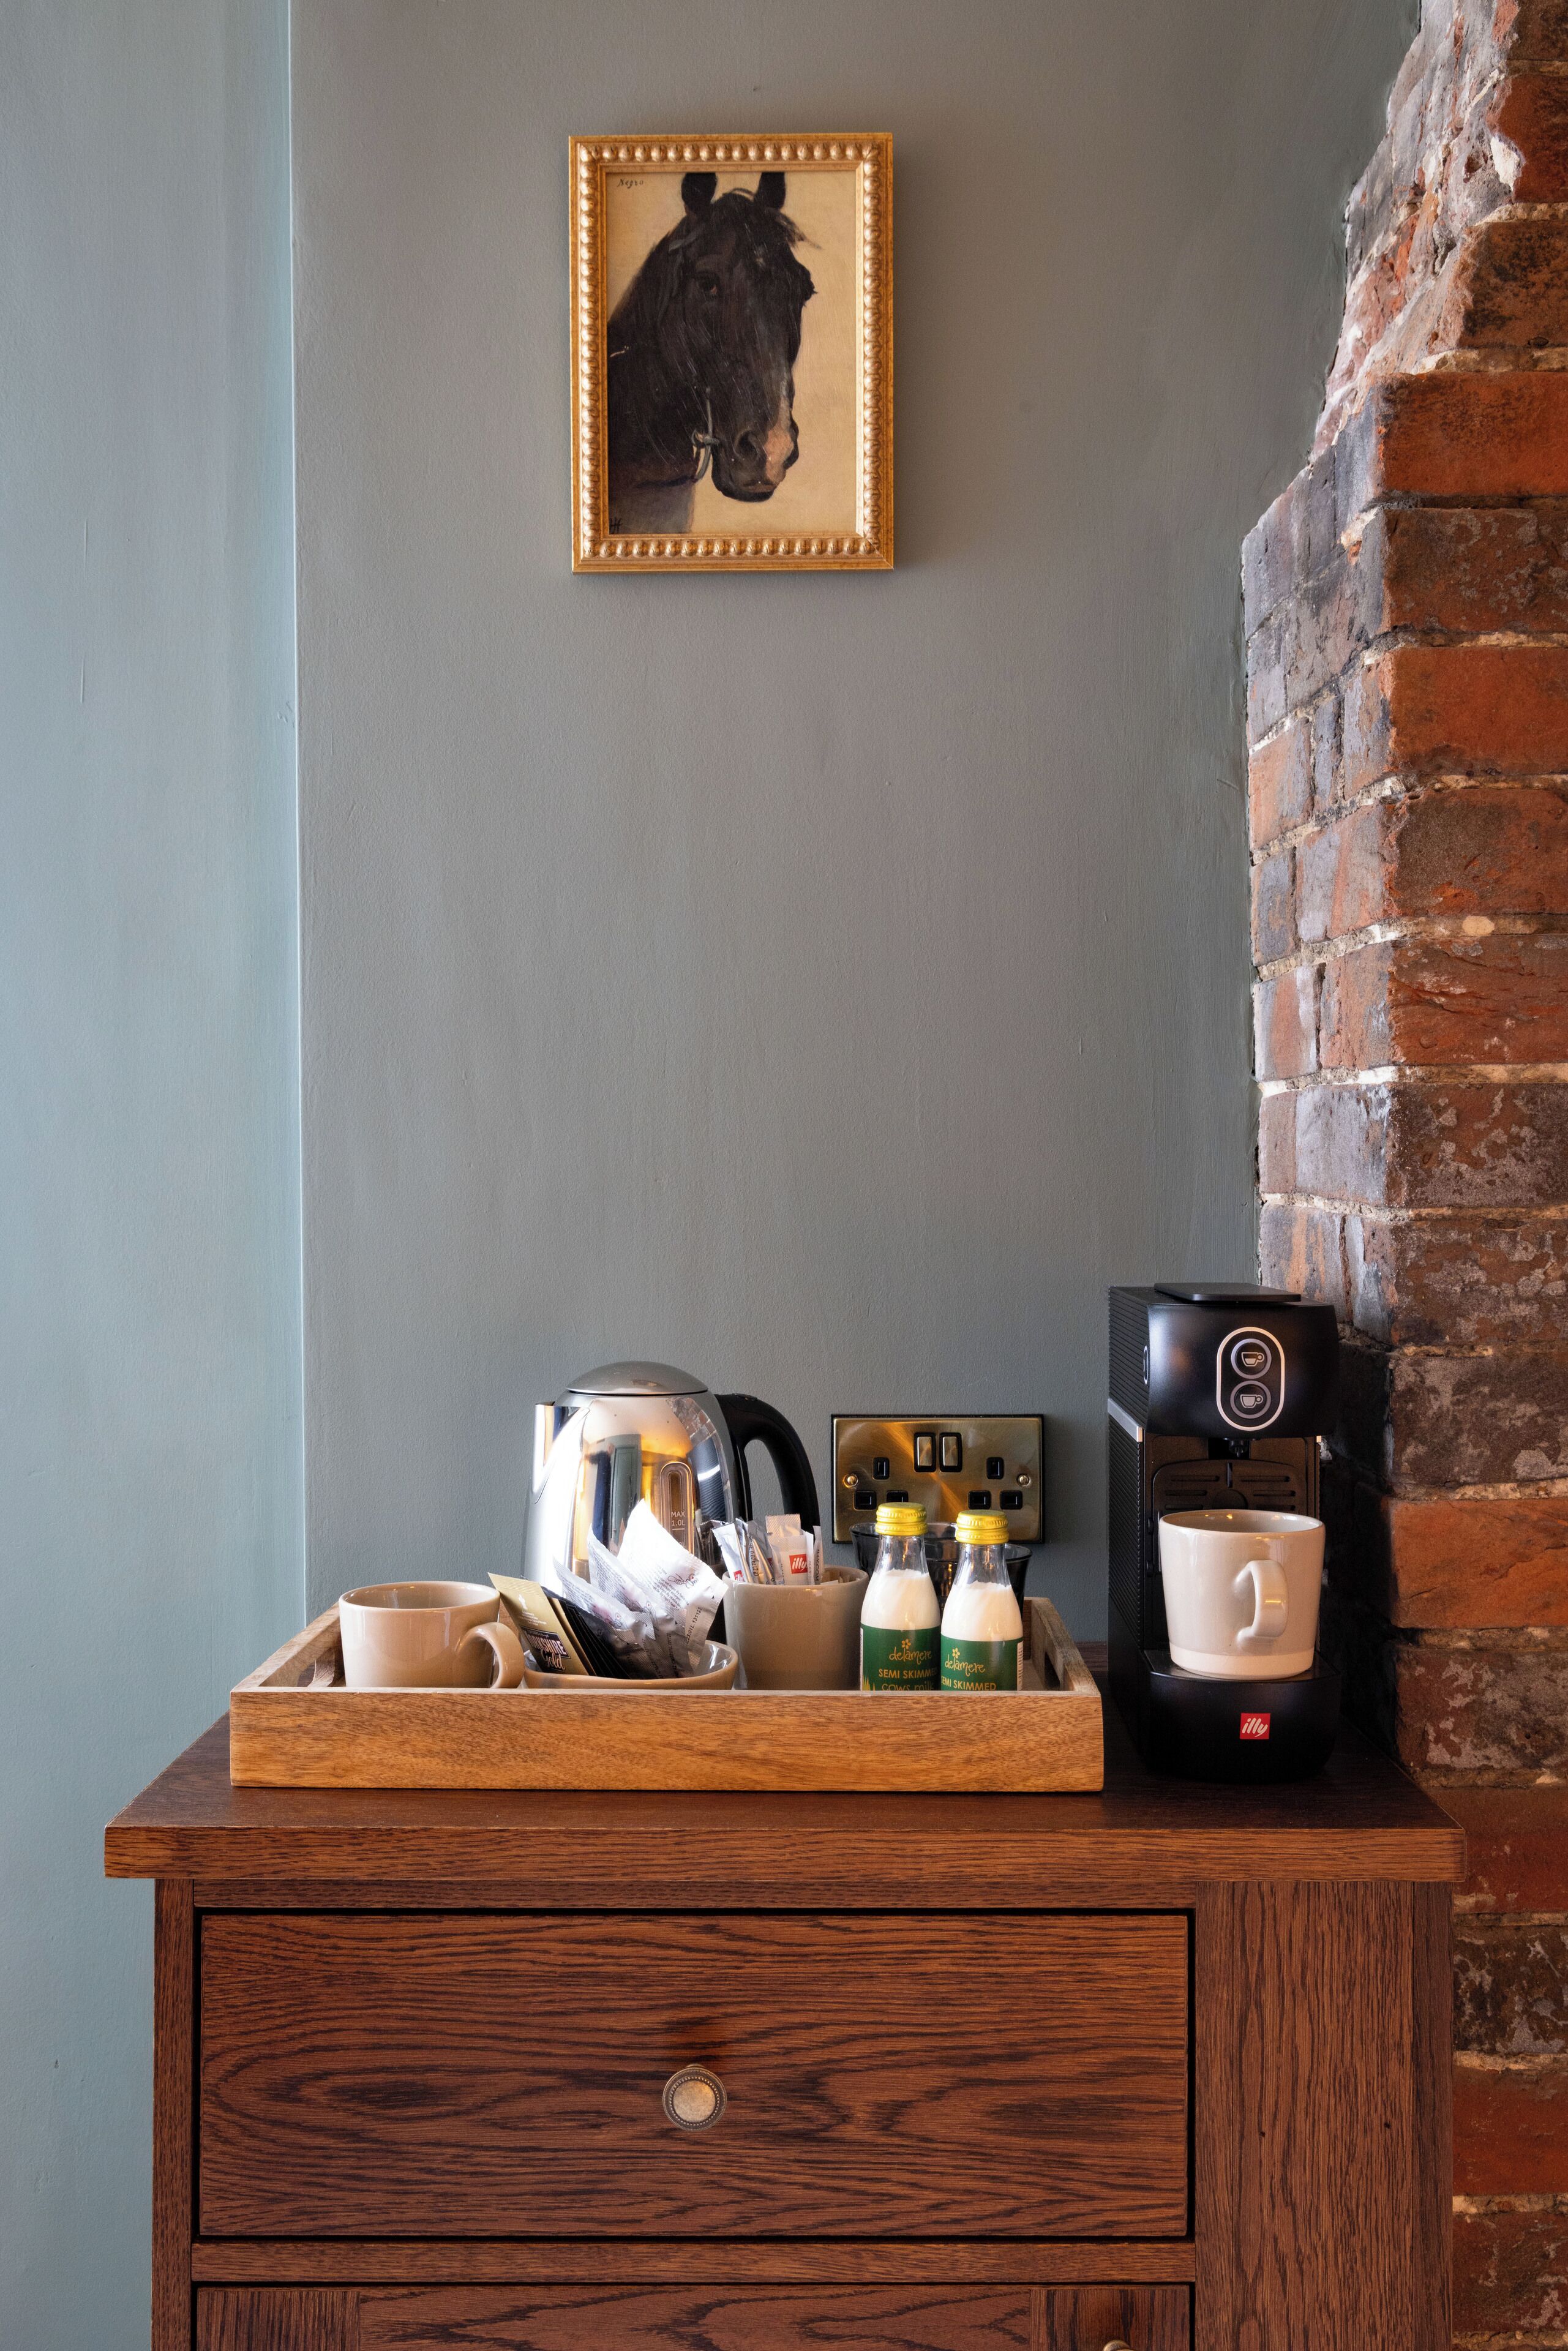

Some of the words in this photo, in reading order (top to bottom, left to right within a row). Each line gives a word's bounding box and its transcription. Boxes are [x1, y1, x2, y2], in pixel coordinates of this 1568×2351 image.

[617, 179, 643, 189] Negro
[792, 1557, 806, 1572] illy
[541, 1649, 566, 1670] Gold
[889, 1646, 932, 1665] delamere
[878, 1668, 900, 1679] SEMI
[902, 1668, 938, 1679] SKIMMED
[945, 1654, 985, 1677] delamere
[953, 1680, 997, 1690] SKIMMED
[1242, 1717, 1268, 1738] illy
